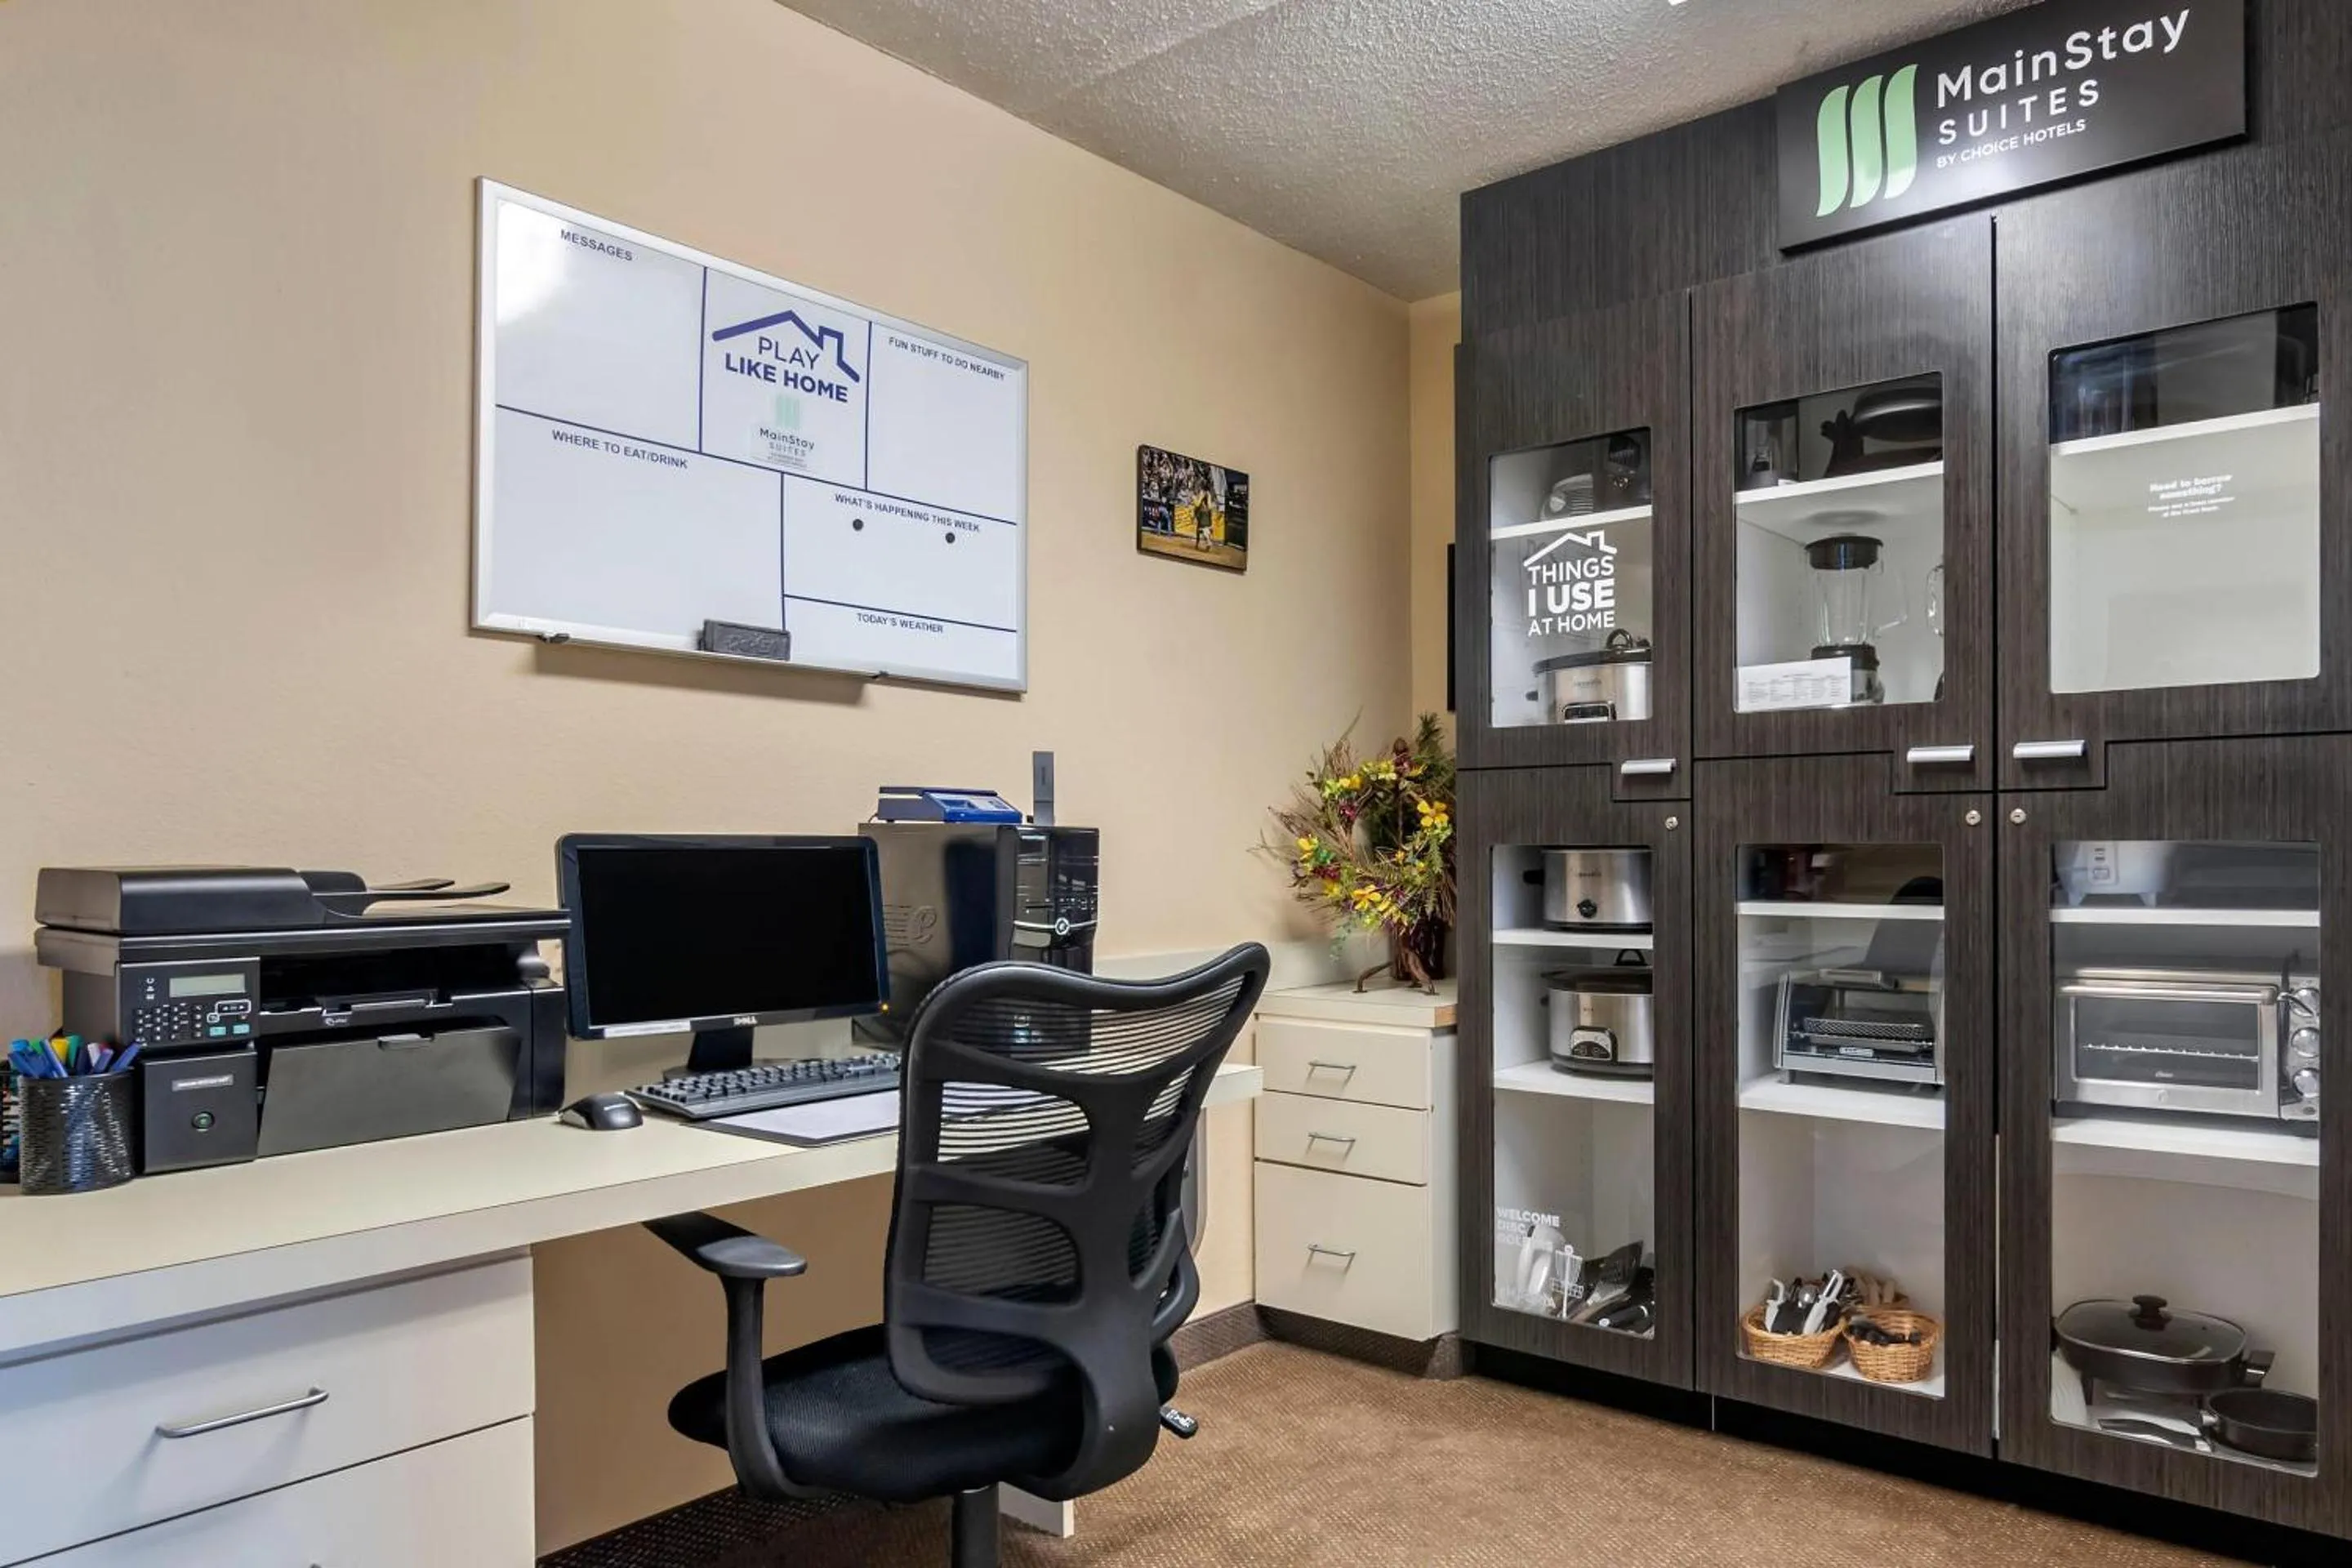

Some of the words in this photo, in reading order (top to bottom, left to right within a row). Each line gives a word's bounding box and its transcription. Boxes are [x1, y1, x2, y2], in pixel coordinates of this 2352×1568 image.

[1937, 9, 2189, 109] MainStay
[1939, 79, 2099, 145] SUITES
[1936, 153, 1957, 168] BY
[1961, 136, 2019, 162] CHOICE
[2024, 118, 2086, 145] HOTELS
[560, 229, 632, 261] MESSAGES
[758, 336, 820, 370] PLAY
[889, 336, 908, 350] FUN
[911, 343, 938, 359] STUFF
[941, 353, 953, 364] TO
[955, 358, 968, 369] DO
[969, 362, 1005, 380] NEARBY
[725, 352, 777, 383] LIKE
[783, 369, 849, 403] HOME
[552, 429, 599, 449] WHERE
[603, 441, 620, 454] TO
[623, 446, 688, 469] EAT/DRINK
[760, 427, 814, 450] MainStay
[835, 493, 872, 510] WHAT'S
[875, 503, 929, 523] HAPPENING
[932, 515, 952, 527] THIS
[954, 520, 980, 532] WEEK
[1527, 555, 1615, 586] THINGS
[1528, 589, 1536, 617] I
[1547, 578, 1615, 614] USE
[857, 612, 898, 627] TODAY'S
[899, 618, 943, 634] WEATHER
[1528, 617, 1553, 637] AT
[1557, 610, 1615, 634] HOME
[1496, 1207, 1561, 1227] WELCOME
